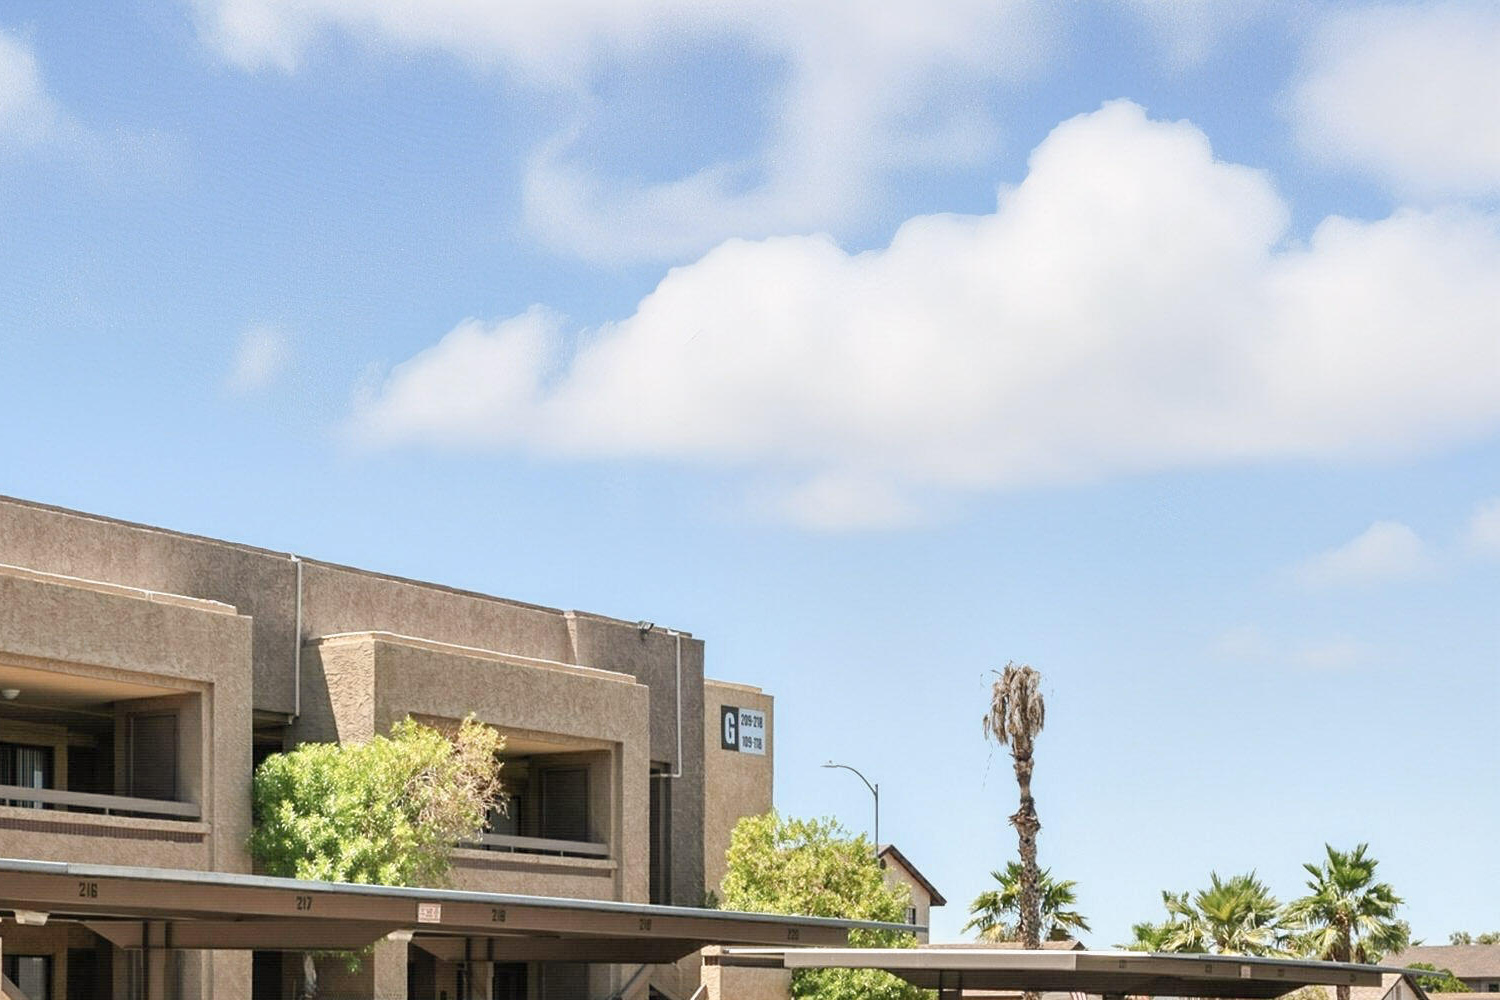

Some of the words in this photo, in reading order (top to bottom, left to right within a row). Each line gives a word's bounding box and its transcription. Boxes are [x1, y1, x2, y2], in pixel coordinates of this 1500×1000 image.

[725, 712, 736, 745] G
[79, 881, 98, 898] 216
[296, 896, 312, 911] 217
